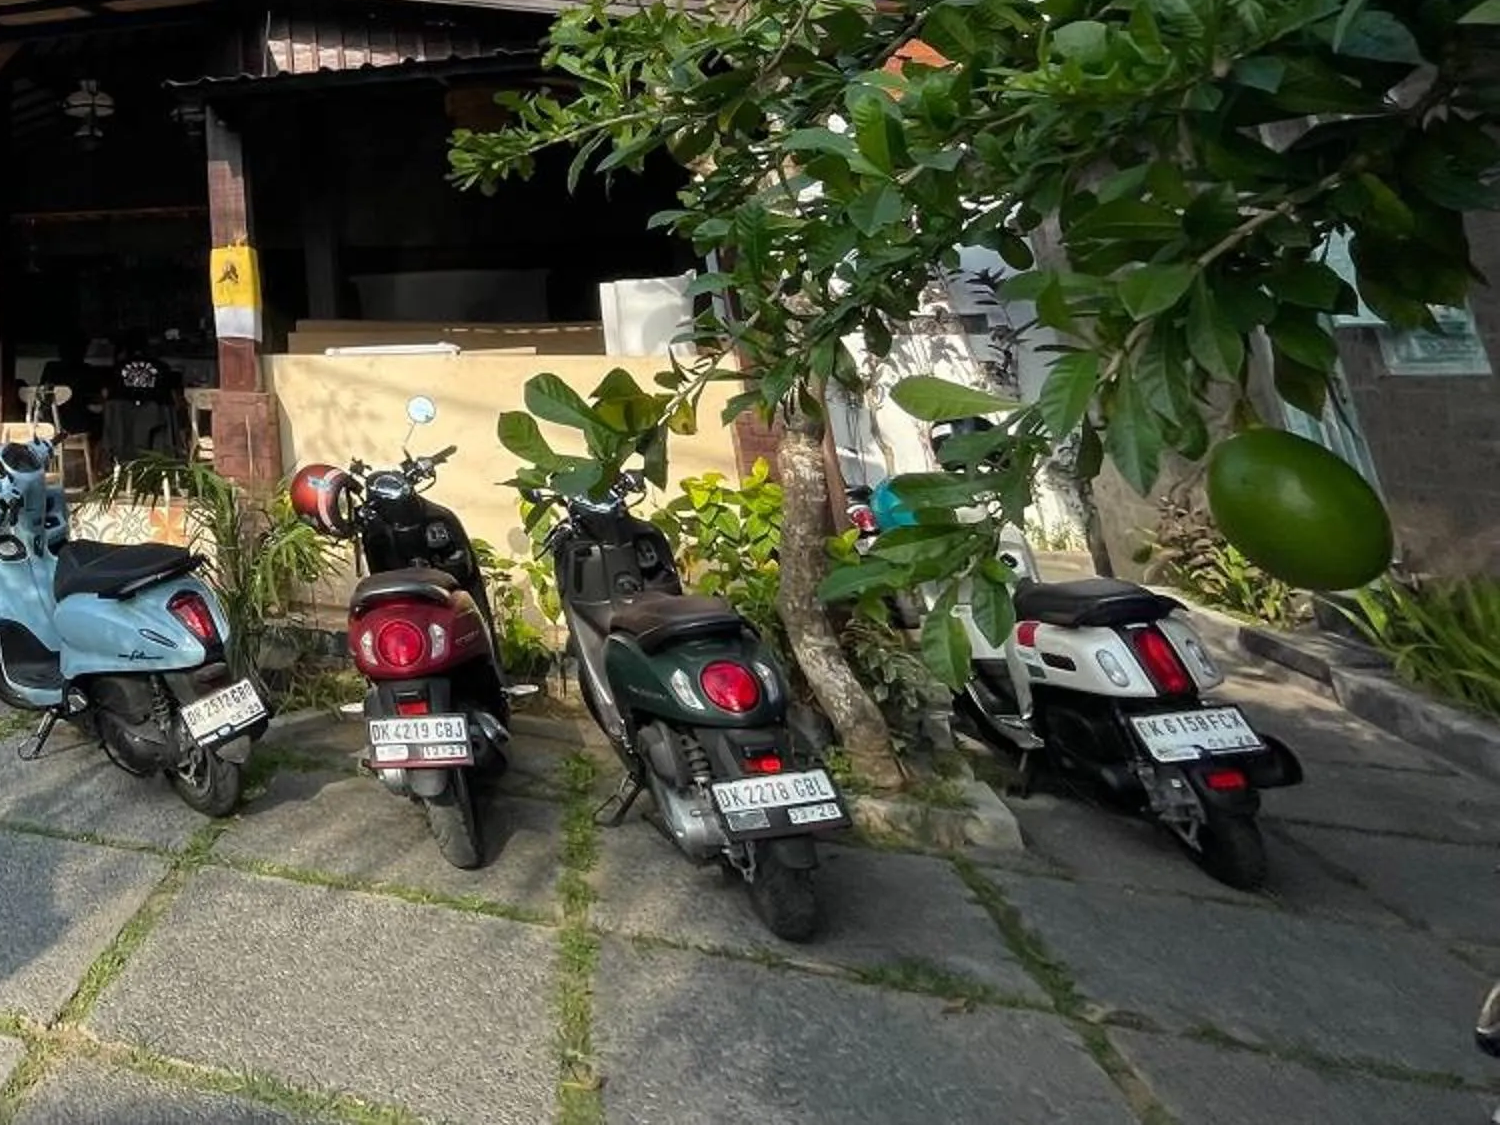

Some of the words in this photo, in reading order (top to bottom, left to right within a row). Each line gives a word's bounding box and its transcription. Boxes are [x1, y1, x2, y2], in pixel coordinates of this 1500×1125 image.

[371, 724, 390, 742] DK
[435, 720, 463, 738] CBJ
[717, 786, 746, 808] DK
[743, 780, 790, 804] 2278
